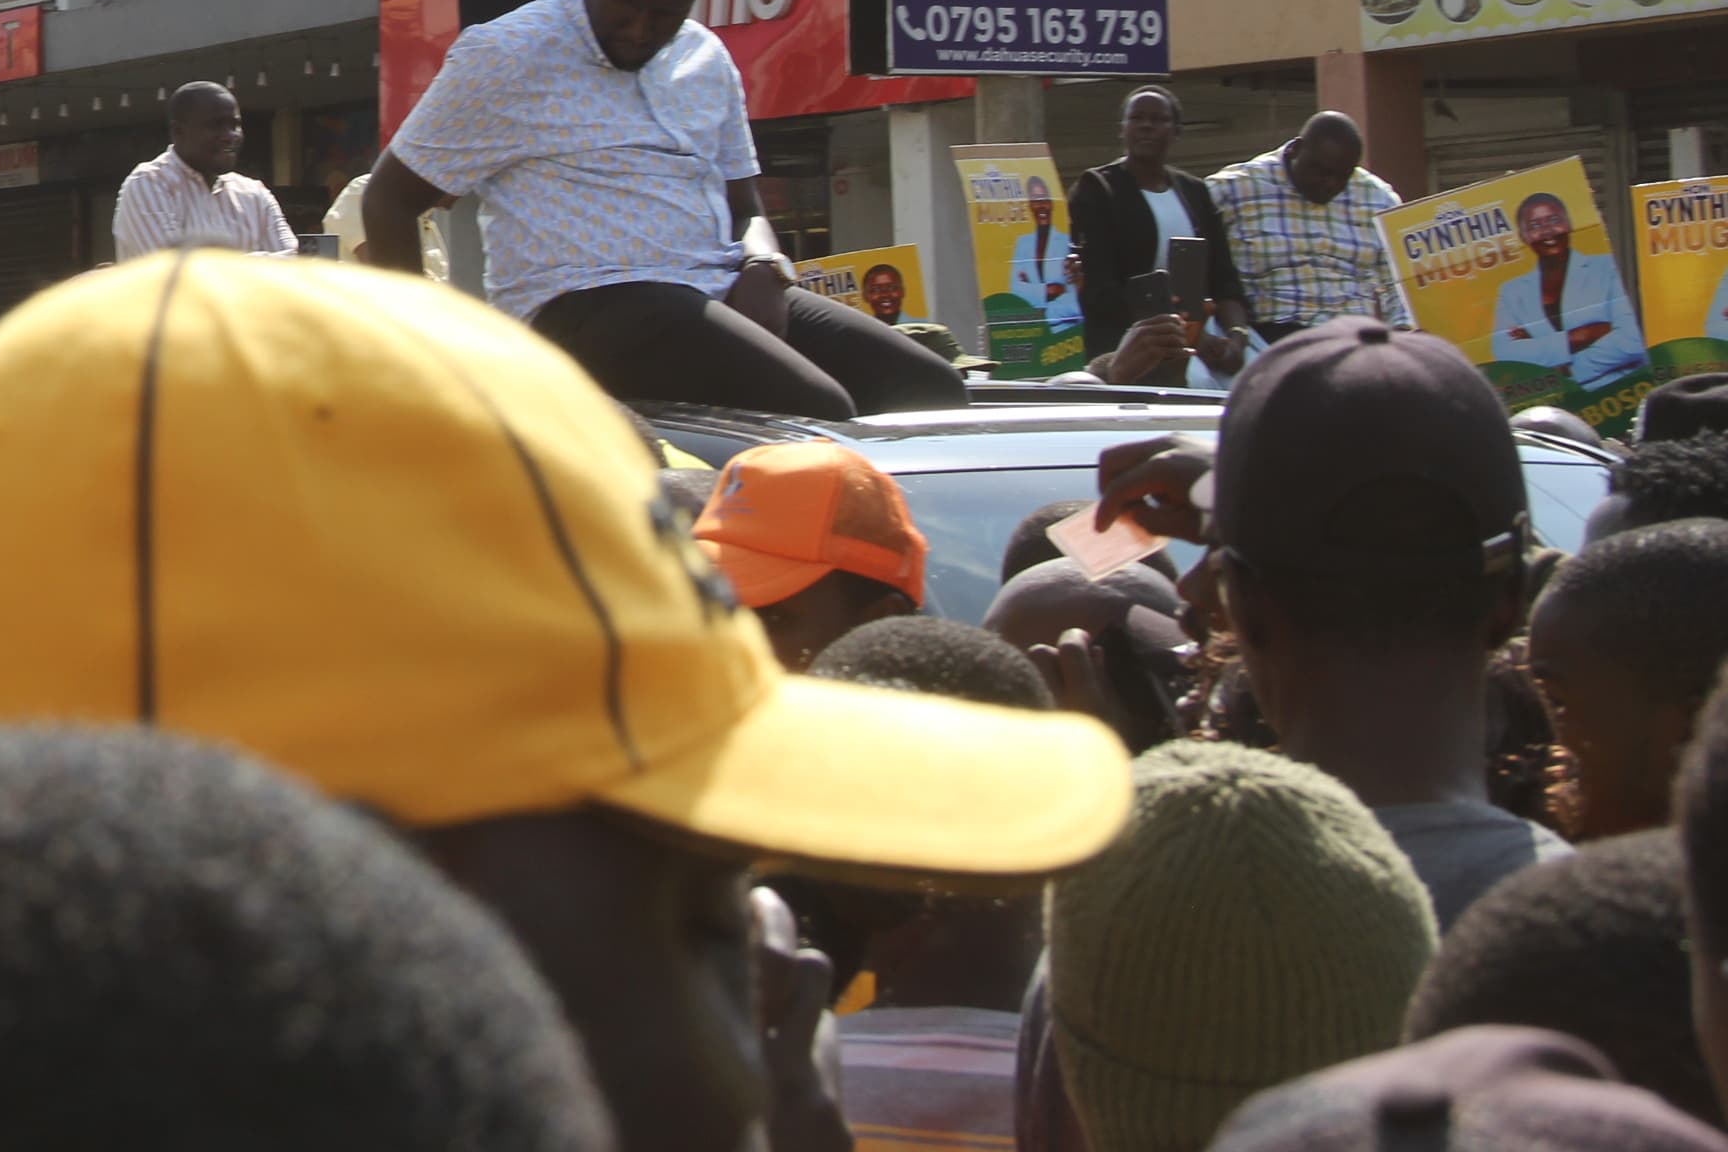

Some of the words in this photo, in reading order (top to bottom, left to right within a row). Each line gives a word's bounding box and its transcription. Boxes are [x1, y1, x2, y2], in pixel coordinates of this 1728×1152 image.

[925, 5, 1018, 45] 0795
[1026, 7, 1088, 46] 163
[1096, 8, 1163, 47] 739
[936, 47, 1129, 68] www.dahuasecurity.com
[1403, 208, 1512, 260] CYNTHIA
[1412, 235, 1522, 288] MUGE
[1576, 381, 1656, 426] BOSO
